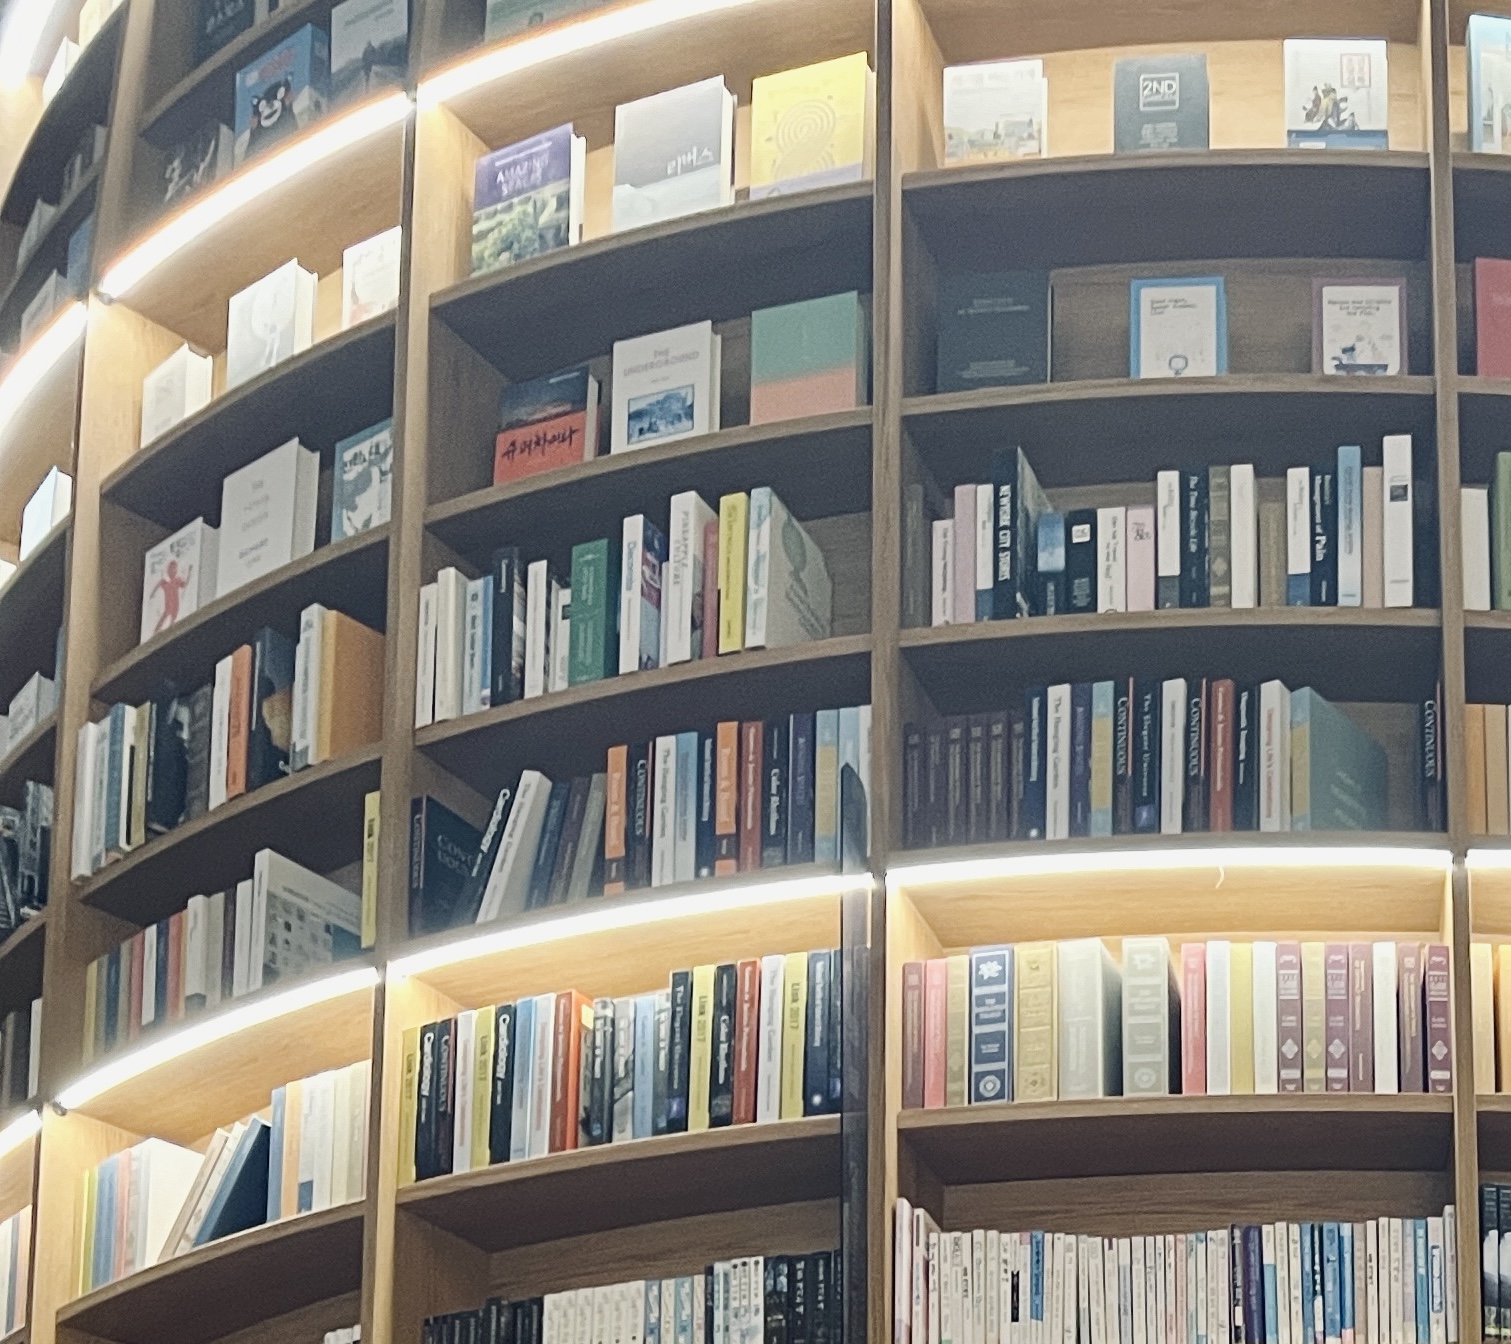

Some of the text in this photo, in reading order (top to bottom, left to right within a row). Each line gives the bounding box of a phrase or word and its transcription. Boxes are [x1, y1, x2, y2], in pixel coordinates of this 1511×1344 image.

[1142, 78, 1178, 95] 2ND
[998, 529, 1011, 548] CITY
[1116, 697, 1129, 776] CONTINUOUS
[1188, 698, 1201, 777] CONTINUOUS
[1423, 700, 1436, 778] CONTINUOUS
[634, 759, 647, 836] CONTINUOUS
[697, 995, 707, 1043] Link 2017
[789, 982, 801, 1030] Link 2017
[495, 1014, 510, 1080] Cardiology
